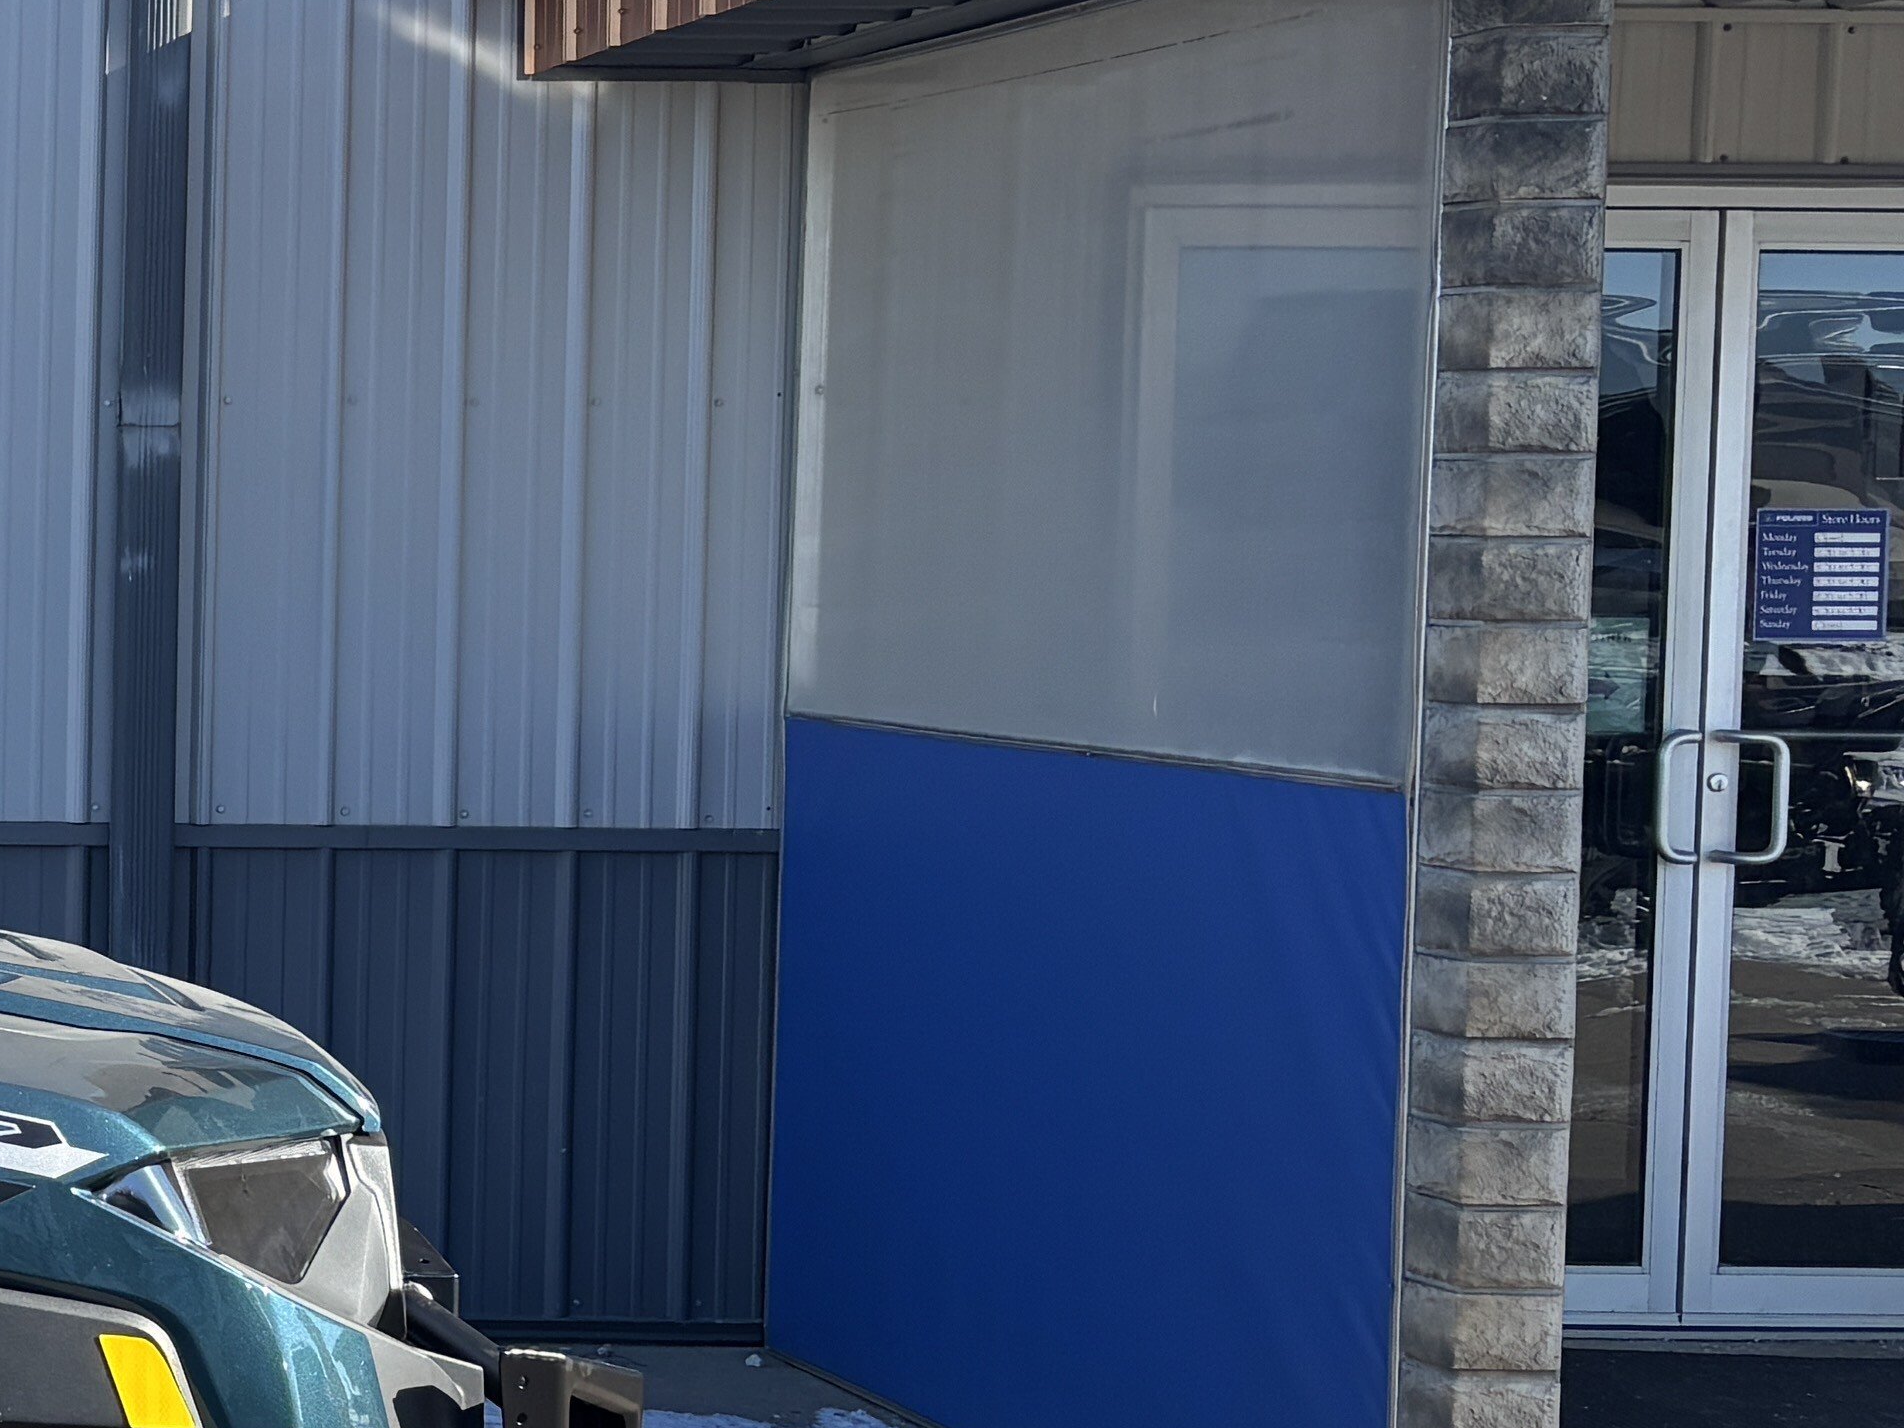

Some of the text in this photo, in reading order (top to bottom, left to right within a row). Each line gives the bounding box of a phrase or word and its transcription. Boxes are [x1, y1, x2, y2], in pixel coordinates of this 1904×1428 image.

[1821, 514, 1846, 524] Store
[1849, 513, 1880, 524] Hours
[1761, 532, 1797, 542] Monday
[1762, 546, 1796, 557] Tuesday
[1761, 561, 1808, 572] Wednesday
[1760, 575, 1801, 586] Thursday
[1760, 590, 1787, 601] Friday
